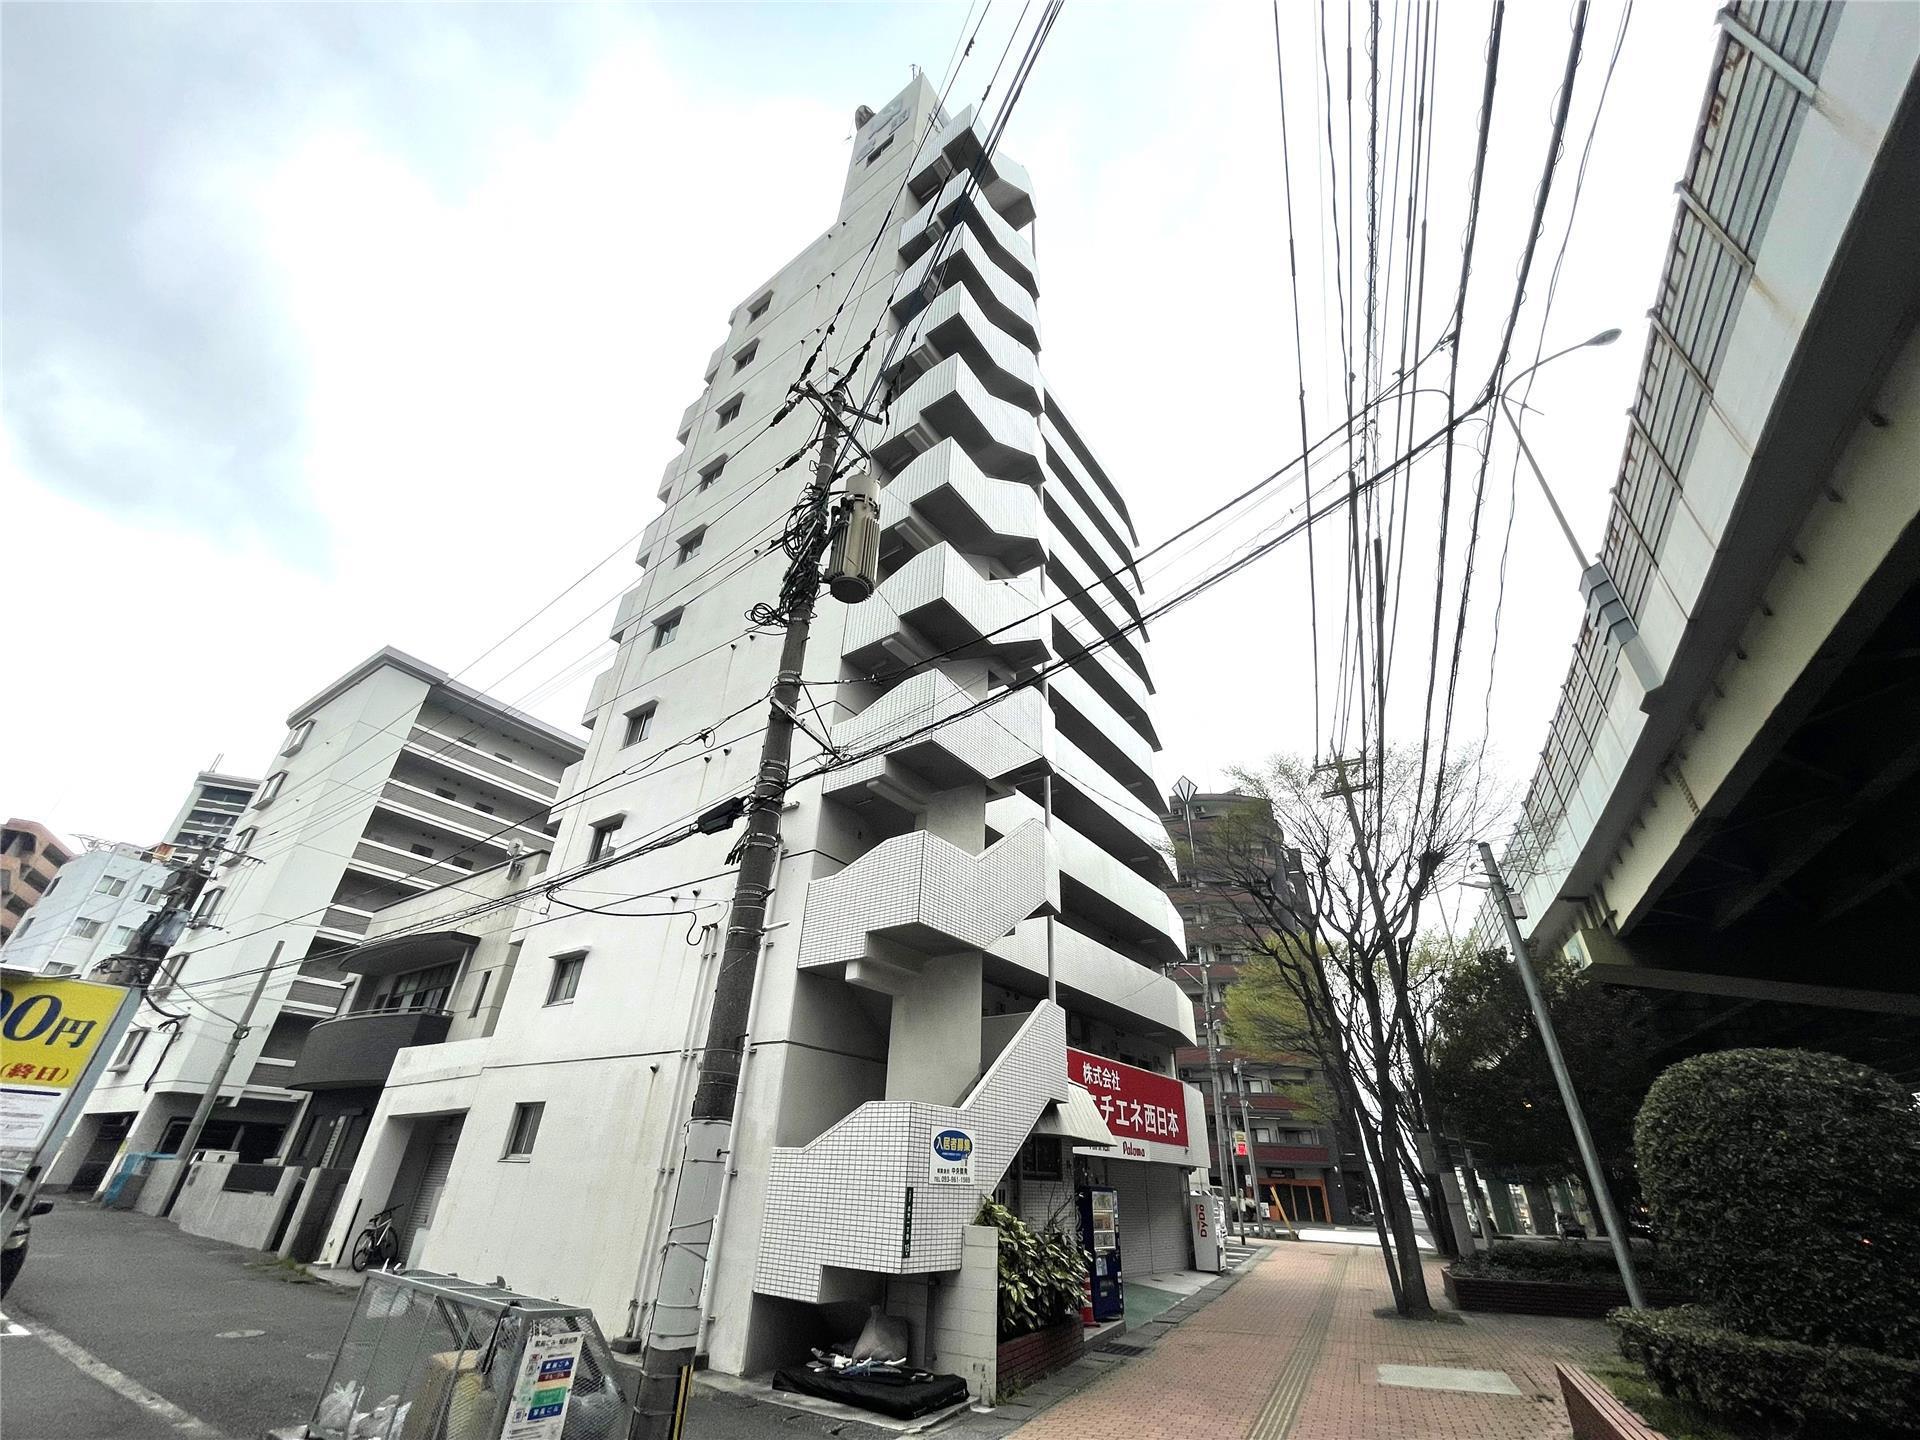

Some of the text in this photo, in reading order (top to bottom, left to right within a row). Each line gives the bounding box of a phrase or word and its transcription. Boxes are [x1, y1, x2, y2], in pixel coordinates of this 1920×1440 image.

[0, 988, 97, 1048] 0円
[1082, 1062, 1121, 1091] 株式会社
[1090, 1094, 1180, 1138] チエネ西日本
[1122, 1141, 1146, 1157] Paloma
[1199, 1204, 1208, 1238] DyDo
